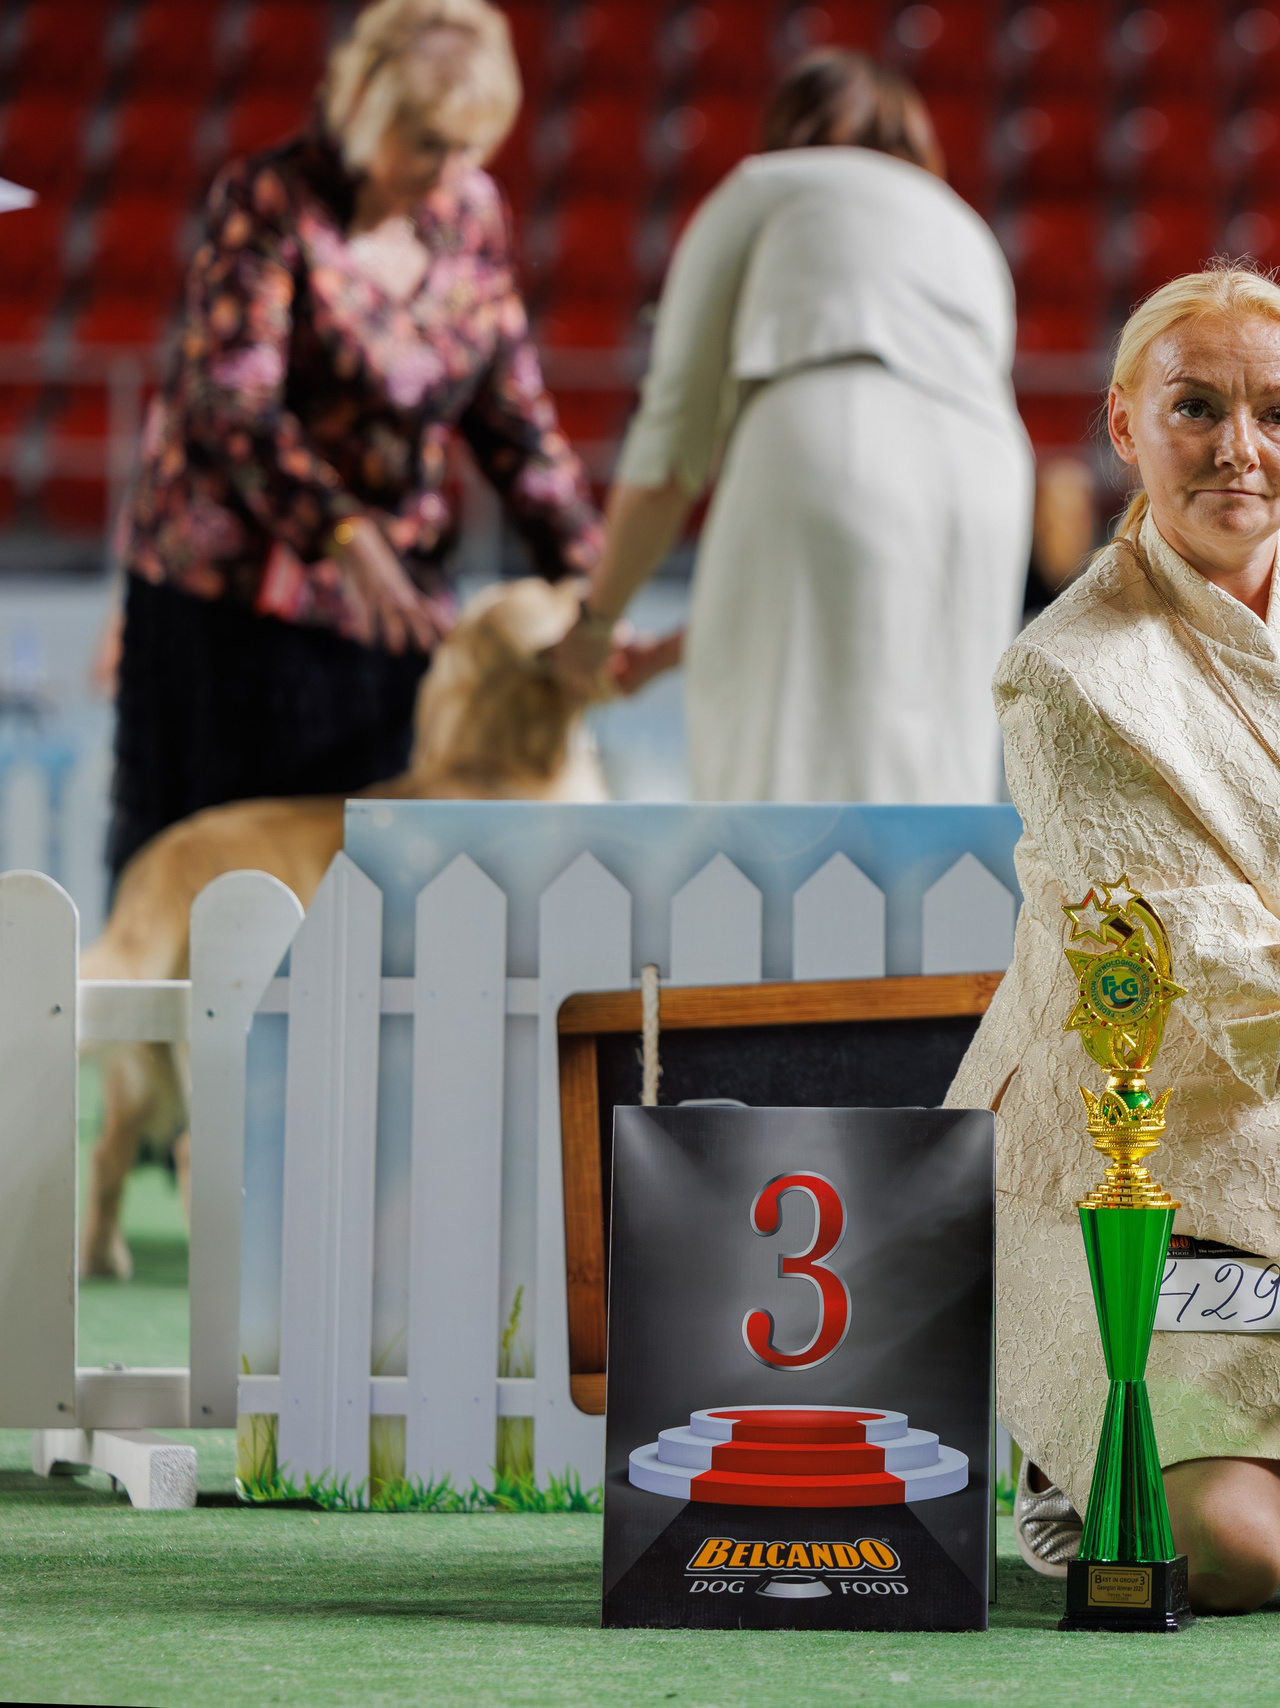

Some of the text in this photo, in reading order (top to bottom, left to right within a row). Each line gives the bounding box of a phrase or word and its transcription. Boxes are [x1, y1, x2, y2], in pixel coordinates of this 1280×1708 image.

[742, 1171, 852, 1371] 3
[688, 1538, 899, 1571] BELCANDO
[689, 1580, 909, 1595] DOG FOOD
[1139, 1576, 1145, 1585] 3
